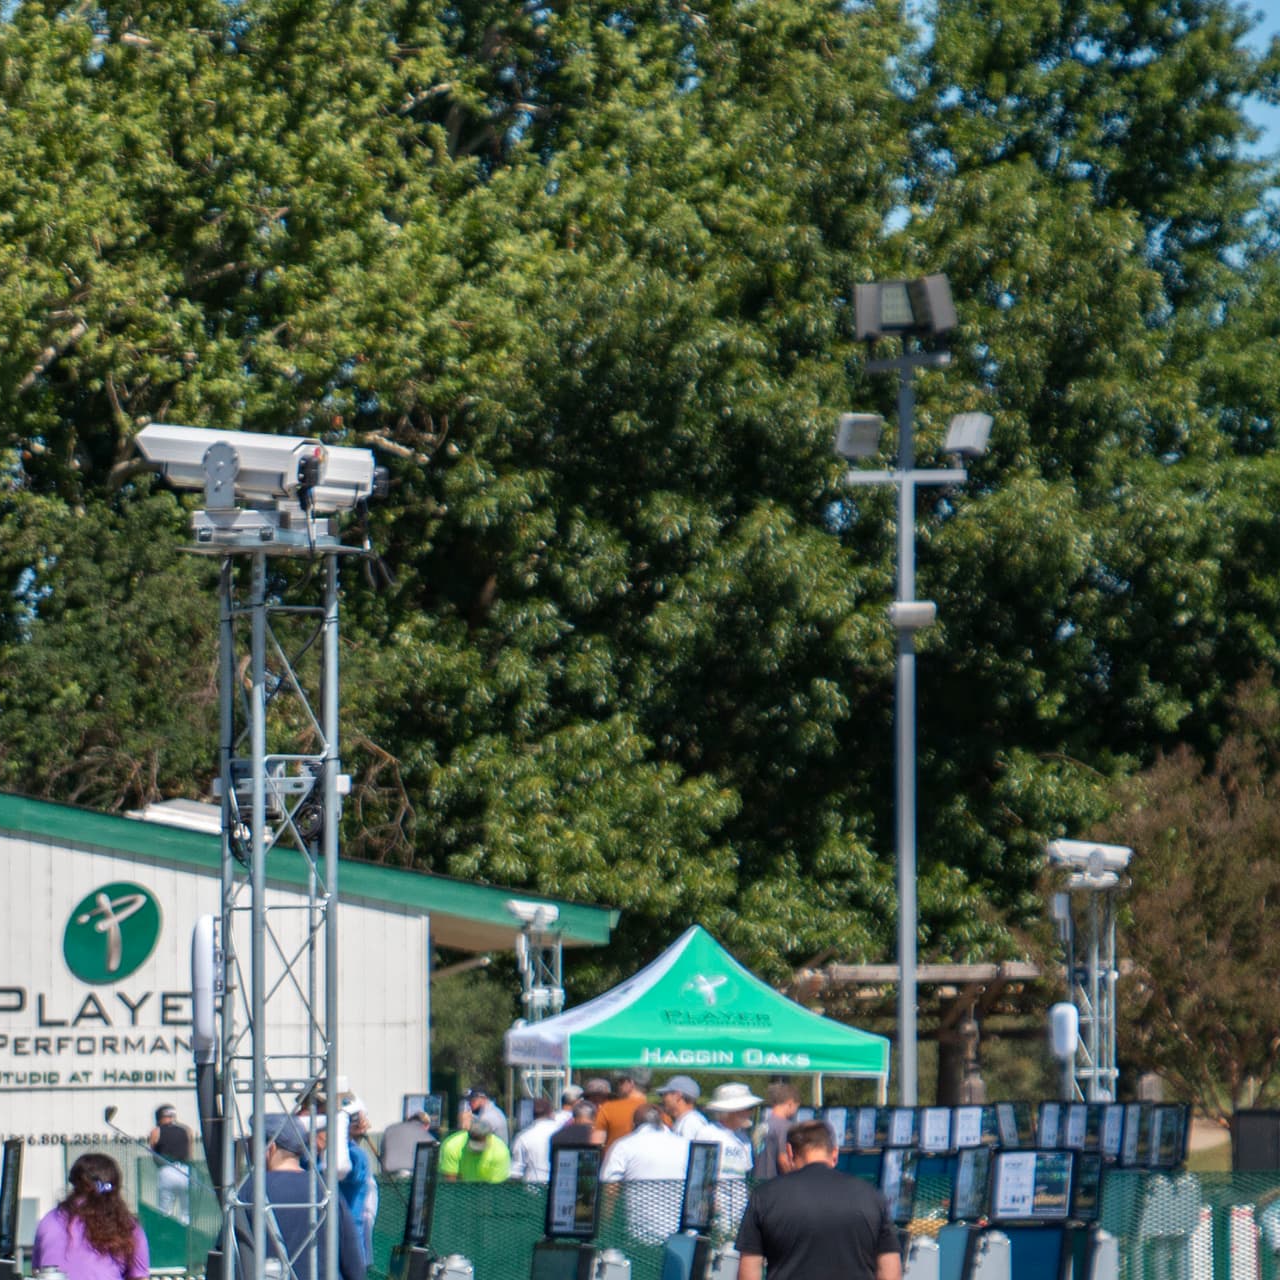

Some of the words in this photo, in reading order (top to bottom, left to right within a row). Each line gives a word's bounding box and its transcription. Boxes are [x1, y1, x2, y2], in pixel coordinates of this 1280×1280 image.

[642, 1047, 734, 1065] HAGGIN
[744, 1048, 811, 1067] OAKS
[69, 1071, 93, 1083] AT
[103, 1068, 176, 1083] HAGGIN
